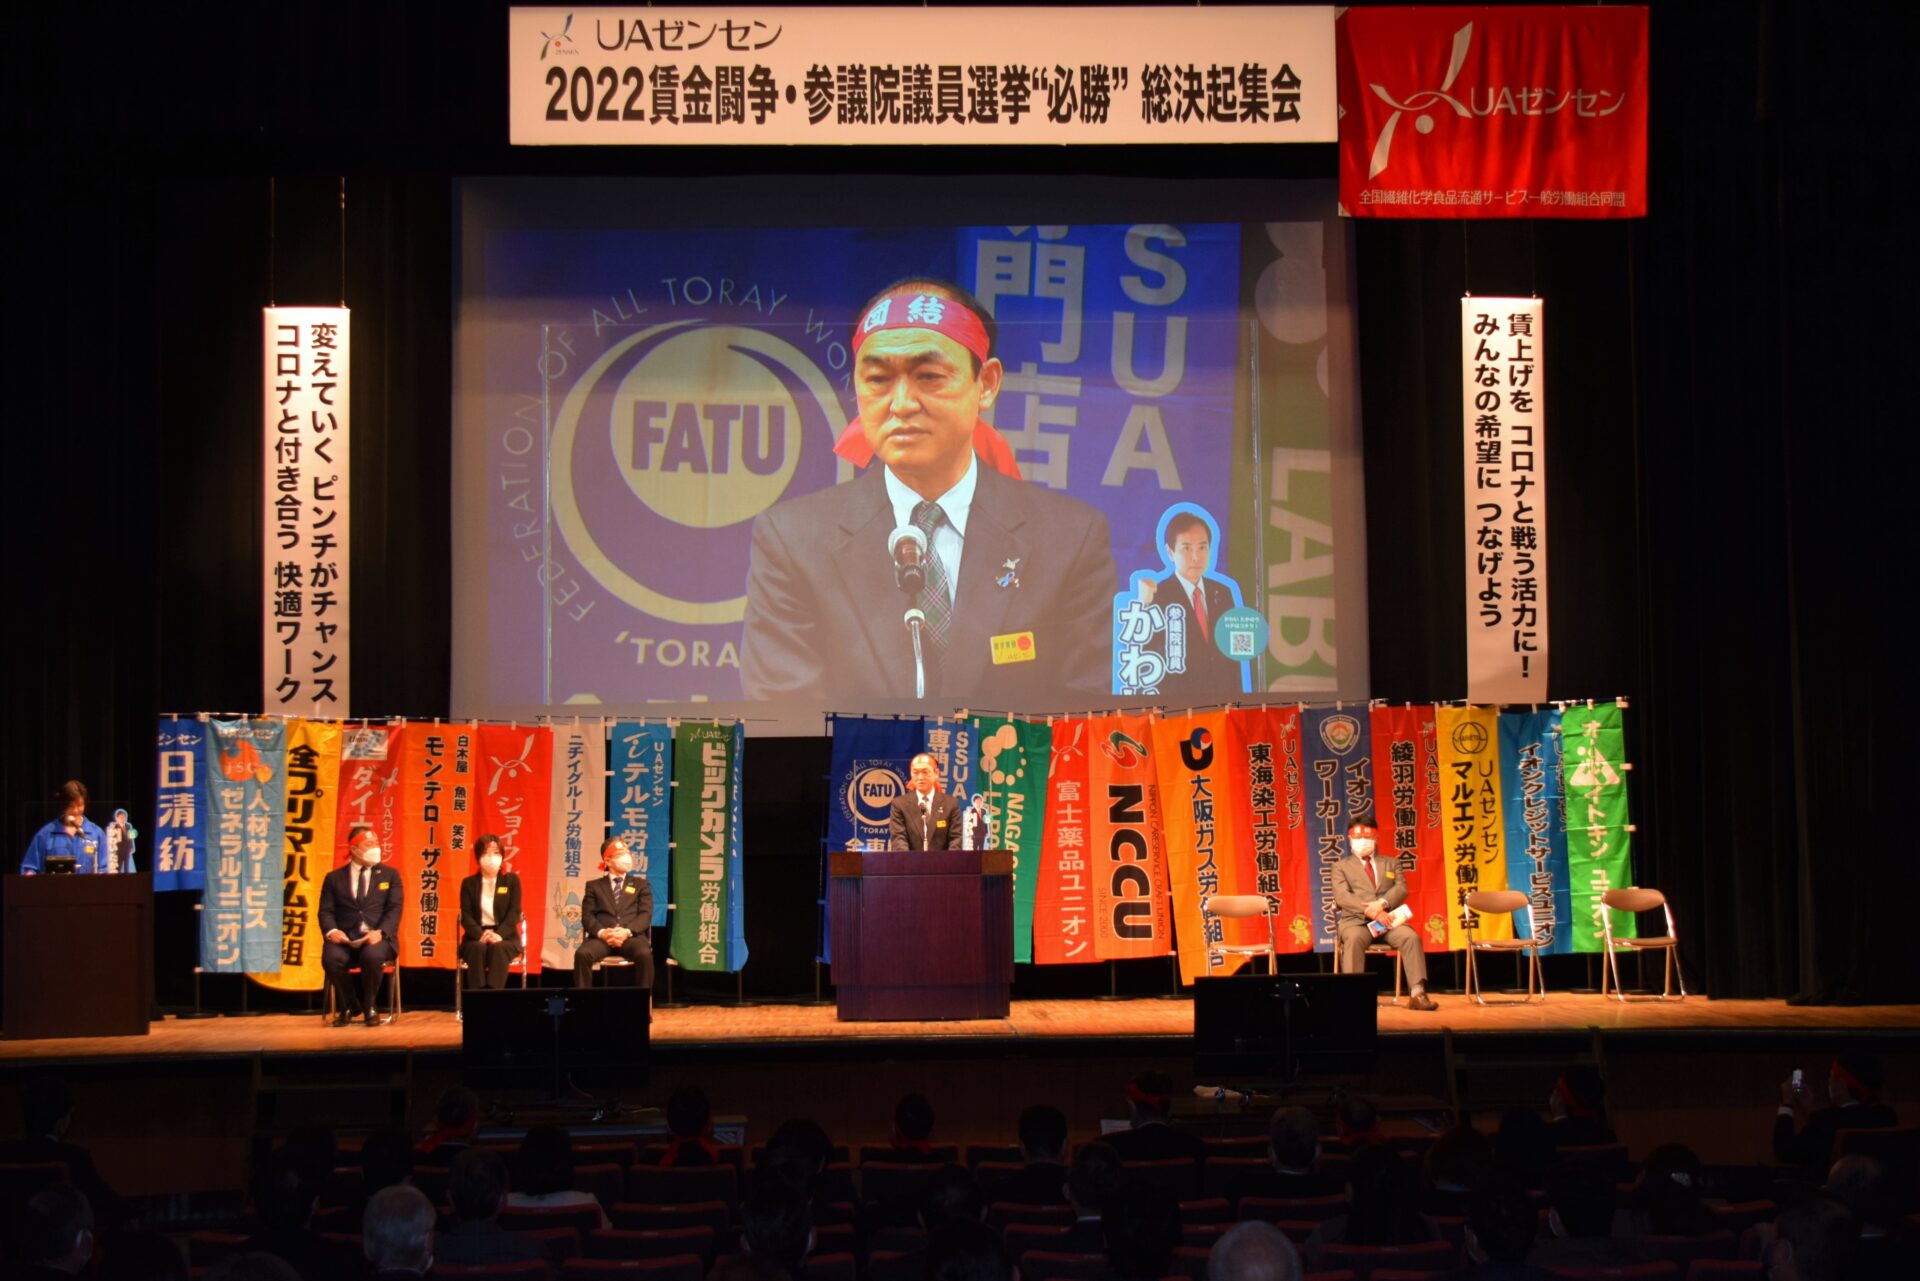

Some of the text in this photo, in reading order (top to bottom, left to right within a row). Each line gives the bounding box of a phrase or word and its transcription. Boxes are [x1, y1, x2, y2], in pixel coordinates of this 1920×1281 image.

[596, 18, 782, 52] UAゼンセン
[1141, 63, 1302, 125] 総決起集会
[1470, 87, 1625, 117] UAゼンセン
[591, 288, 649, 336] ALL
[661, 276, 788, 317] TORAY
[538, 331, 578, 380] OF
[975, 225, 1086, 490] 門店
[1507, 313, 1534, 413] 賃上げを
[631, 400, 786, 476] FATU
[1473, 313, 1503, 627] みんなの希望に つなげよう
[274, 324, 303, 703] コロナと付き合う 快適ワーク
[310, 323, 338, 702] 変えていく ピンチがチャンス
[502, 393, 595, 622] FEDERATION
[158, 751, 195, 872] 日清紡
[453, 785, 467, 812] 魚民
[455, 735, 469, 773] 白木屋
[564, 734, 584, 878] ニチイグループ労働組合
[653, 742, 665, 807] UAゼンセン
[863, 783, 893, 798] FATU
[952, 731, 969, 800] SSUA
[1147, 784, 1157, 819] NIPPON
[1283, 740, 1302, 829] UAゼンセン
[1345, 757, 1372, 817] イオン
[1391, 741, 1417, 872] 綾羽労働組合
[1424, 739, 1441, 829] UAゼンセン
[1478, 760, 1499, 865] UAゼンセン
[217, 786, 245, 965] ゼネラルユニオン
[245, 788, 270, 929] 人材サービス
[281, 744, 324, 967] 全プリマハム労組
[420, 736, 445, 958] モンテローザ労働組合
[620, 762, 651, 879] テルモ労働
[698, 742, 727, 965] ビックカメラ労働組合
[1056, 780, 1088, 958] 富士薬品ユニオン
[1108, 783, 1153, 941] NCCU
[1248, 743, 1281, 917] 東海染工労働組合
[1451, 760, 1481, 930] マルエツ労働組合
[1518, 742, 1554, 948] イオンクレジットサービスユニオン
